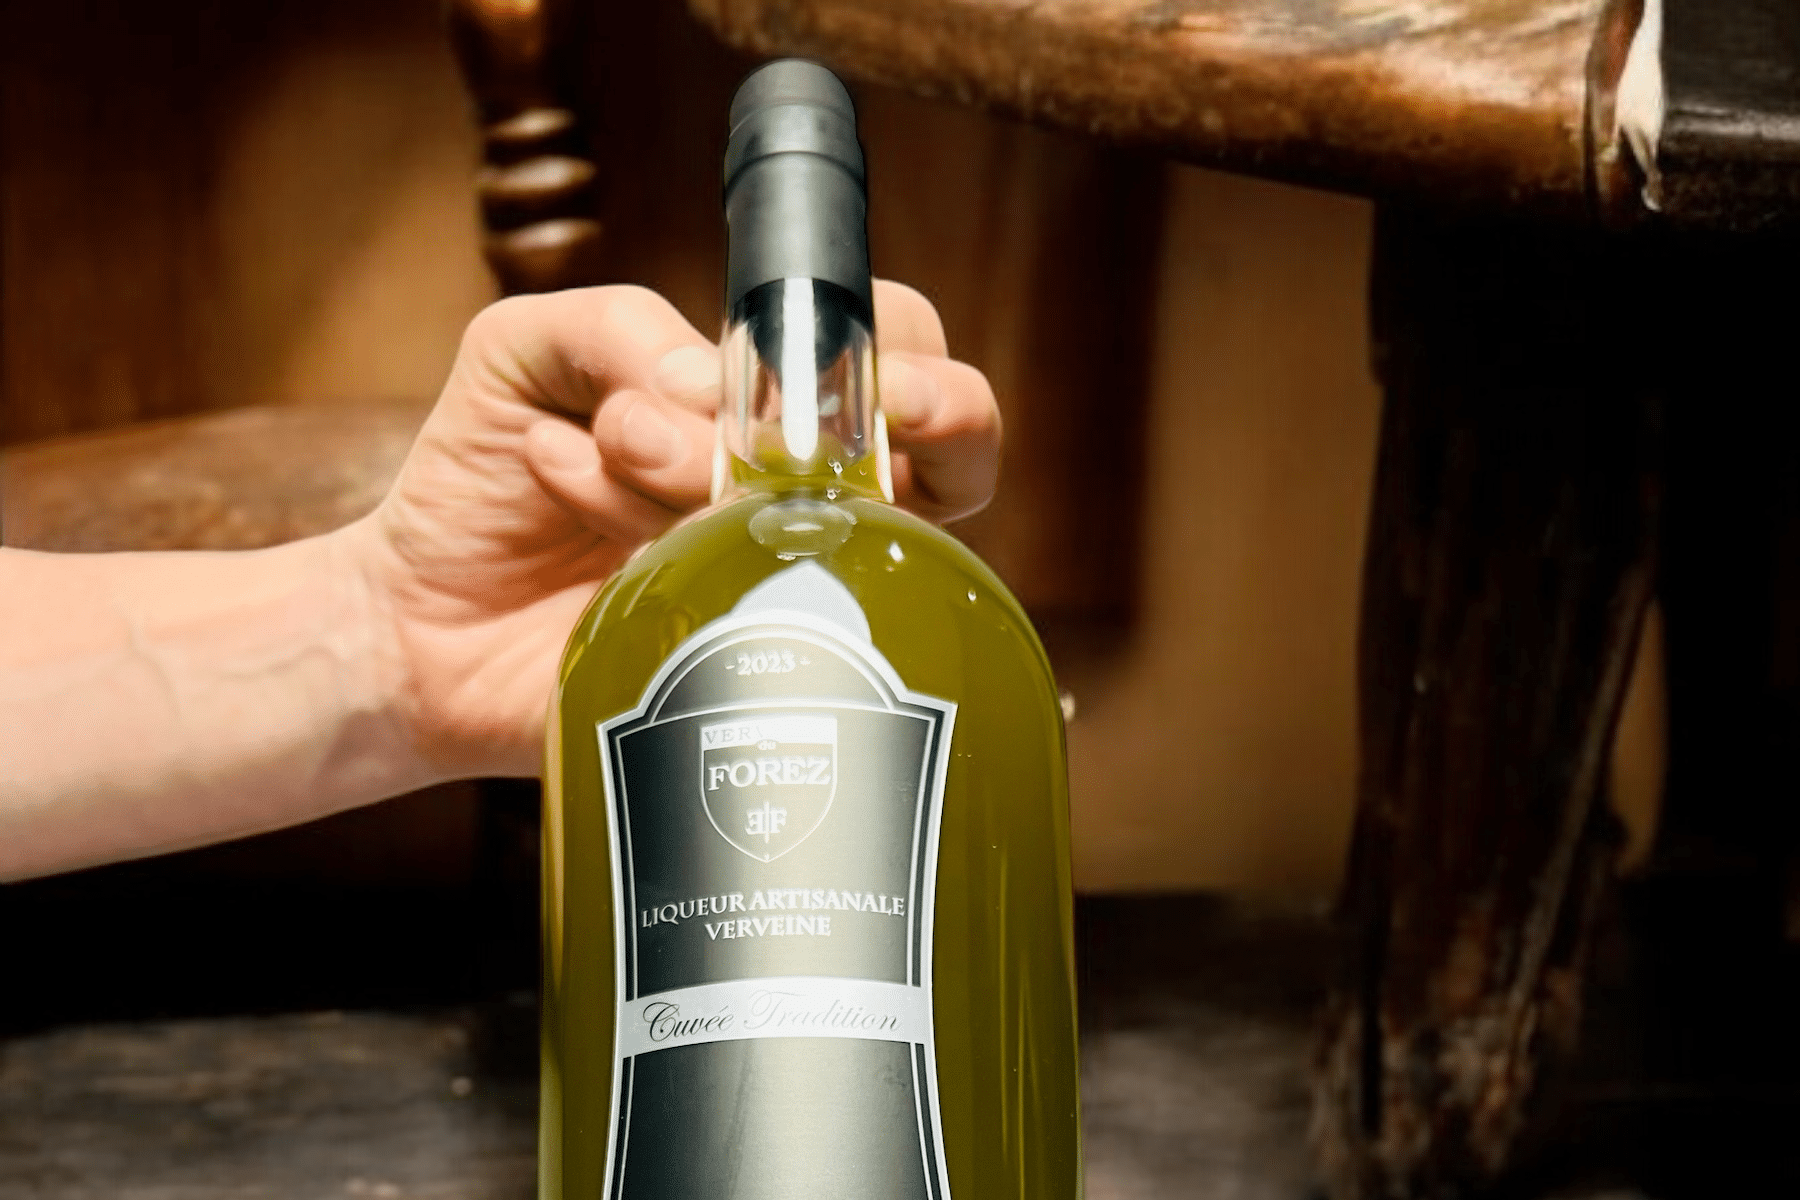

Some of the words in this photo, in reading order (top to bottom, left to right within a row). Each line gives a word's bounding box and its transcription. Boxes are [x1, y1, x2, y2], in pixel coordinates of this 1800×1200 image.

[708, 757, 832, 791] FOREZ
[642, 891, 748, 928] LIQUEUR
[749, 888, 905, 916] ARTISANALE
[704, 914, 832, 940] VERVEINE
[643, 1001, 734, 1042] Cuvée
[743, 989, 901, 1032] Tradition
